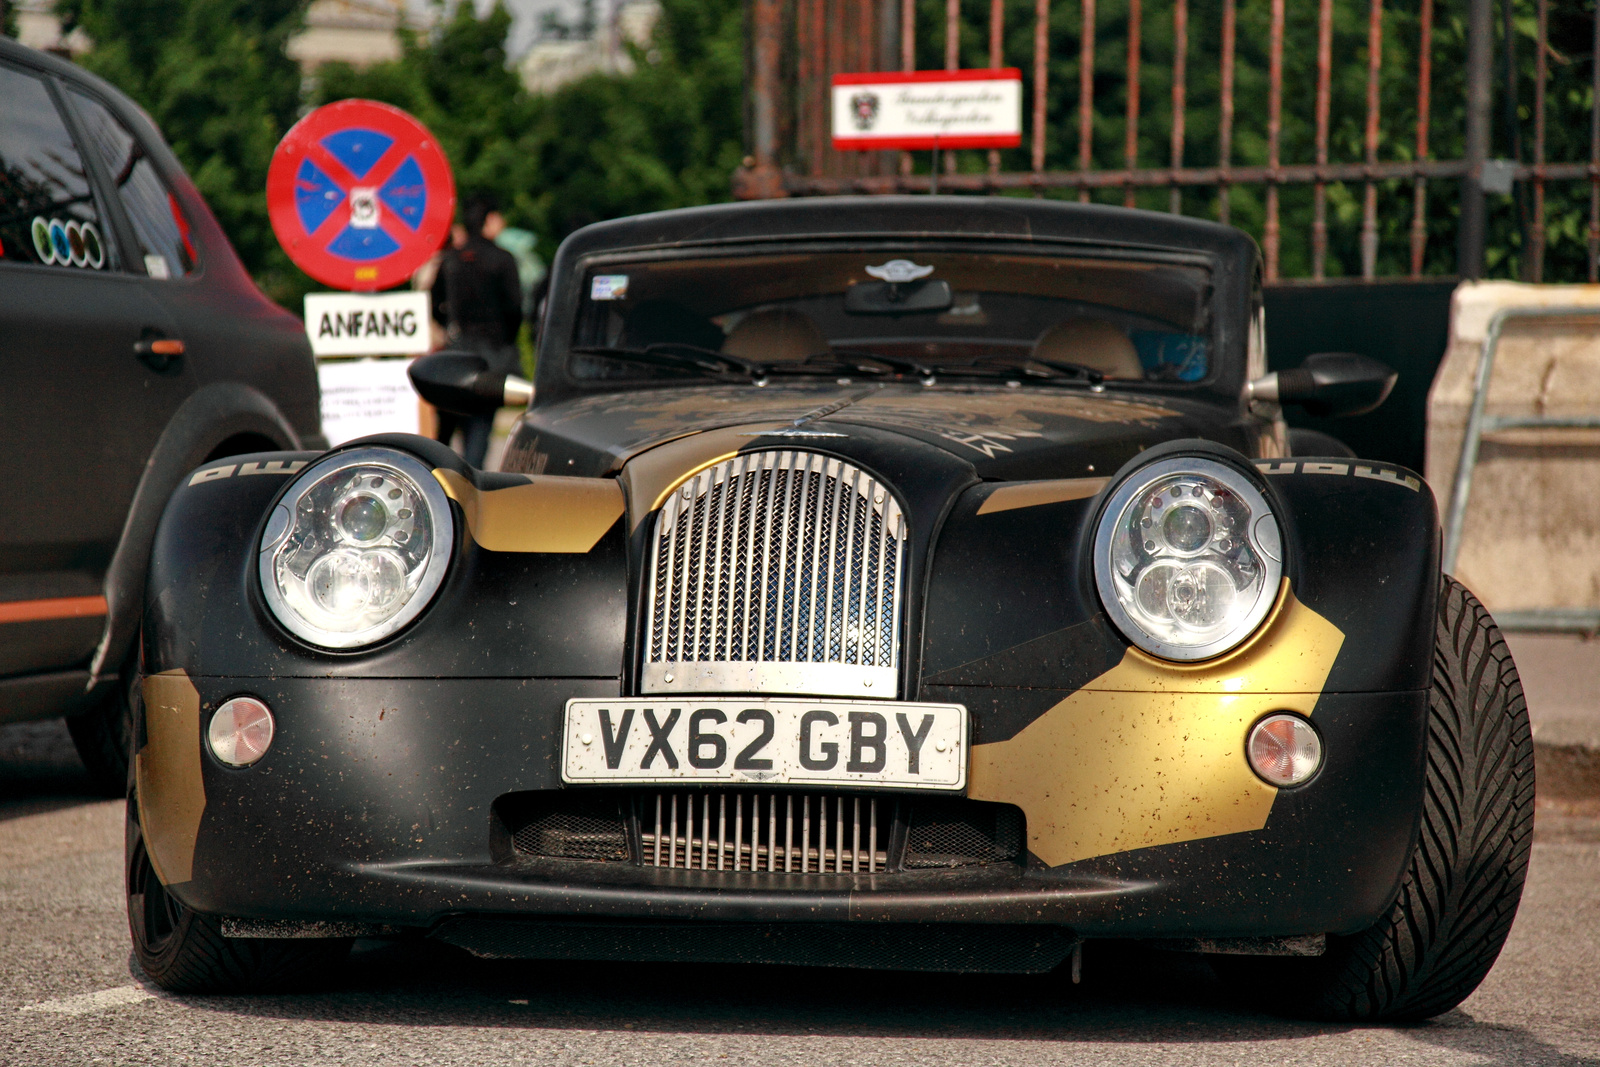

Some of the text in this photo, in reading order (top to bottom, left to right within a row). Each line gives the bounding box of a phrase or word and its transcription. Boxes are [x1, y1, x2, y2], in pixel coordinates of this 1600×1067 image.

[319, 311, 417, 339] ANFANG
[598, 708, 935, 774] VX62 GBY
